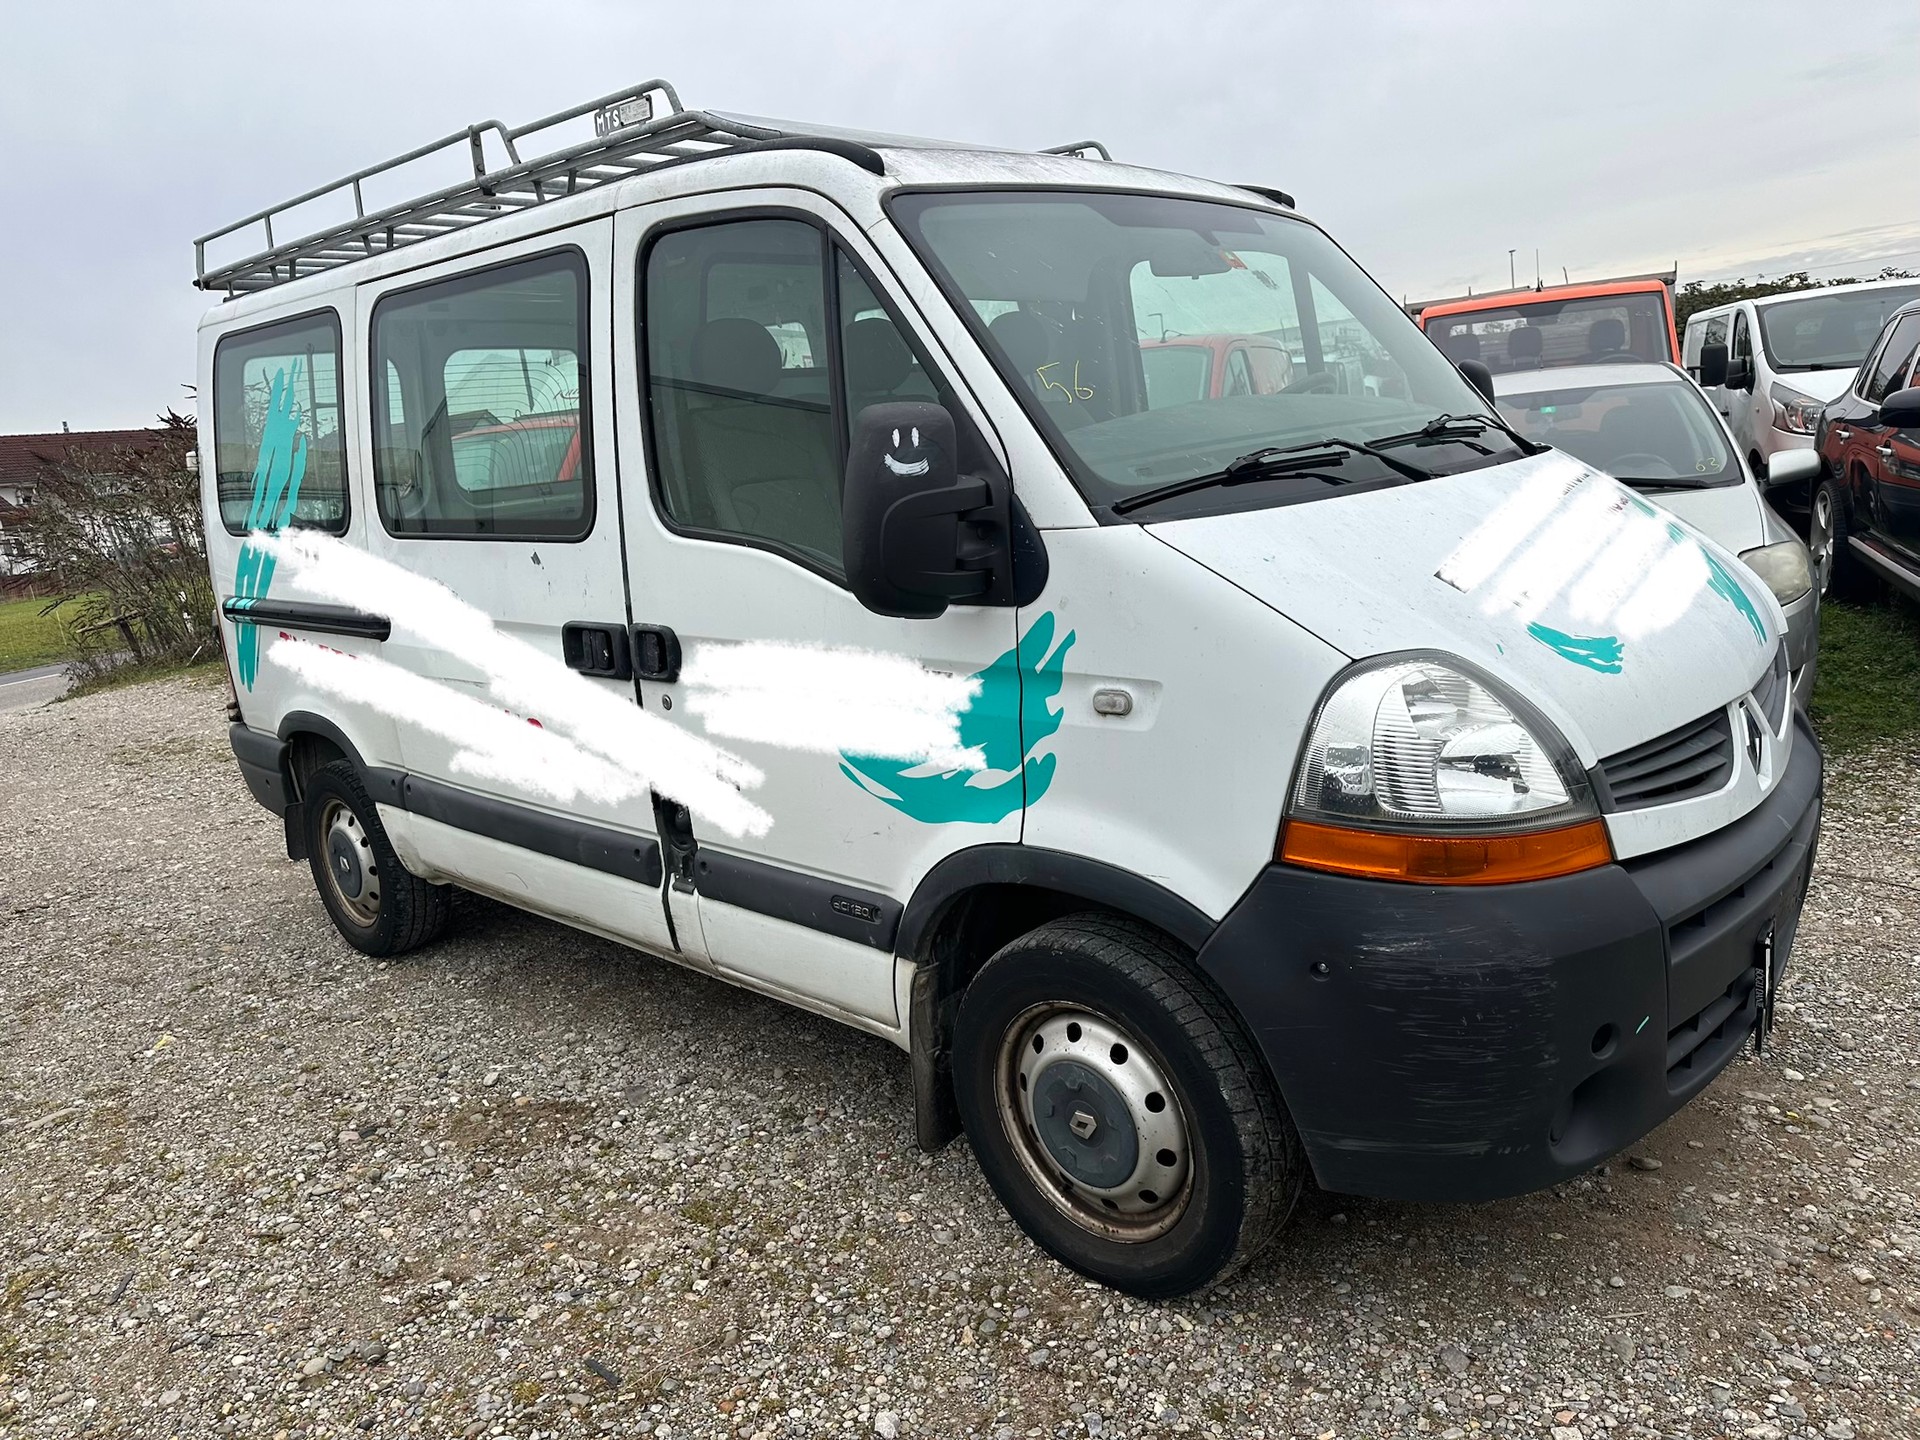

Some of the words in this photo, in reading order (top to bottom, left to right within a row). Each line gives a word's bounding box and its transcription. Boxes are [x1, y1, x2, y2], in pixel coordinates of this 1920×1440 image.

[596, 109, 620, 133] MTS
[1036, 360, 1094, 404] 56
[1695, 457, 1720, 473] 63
